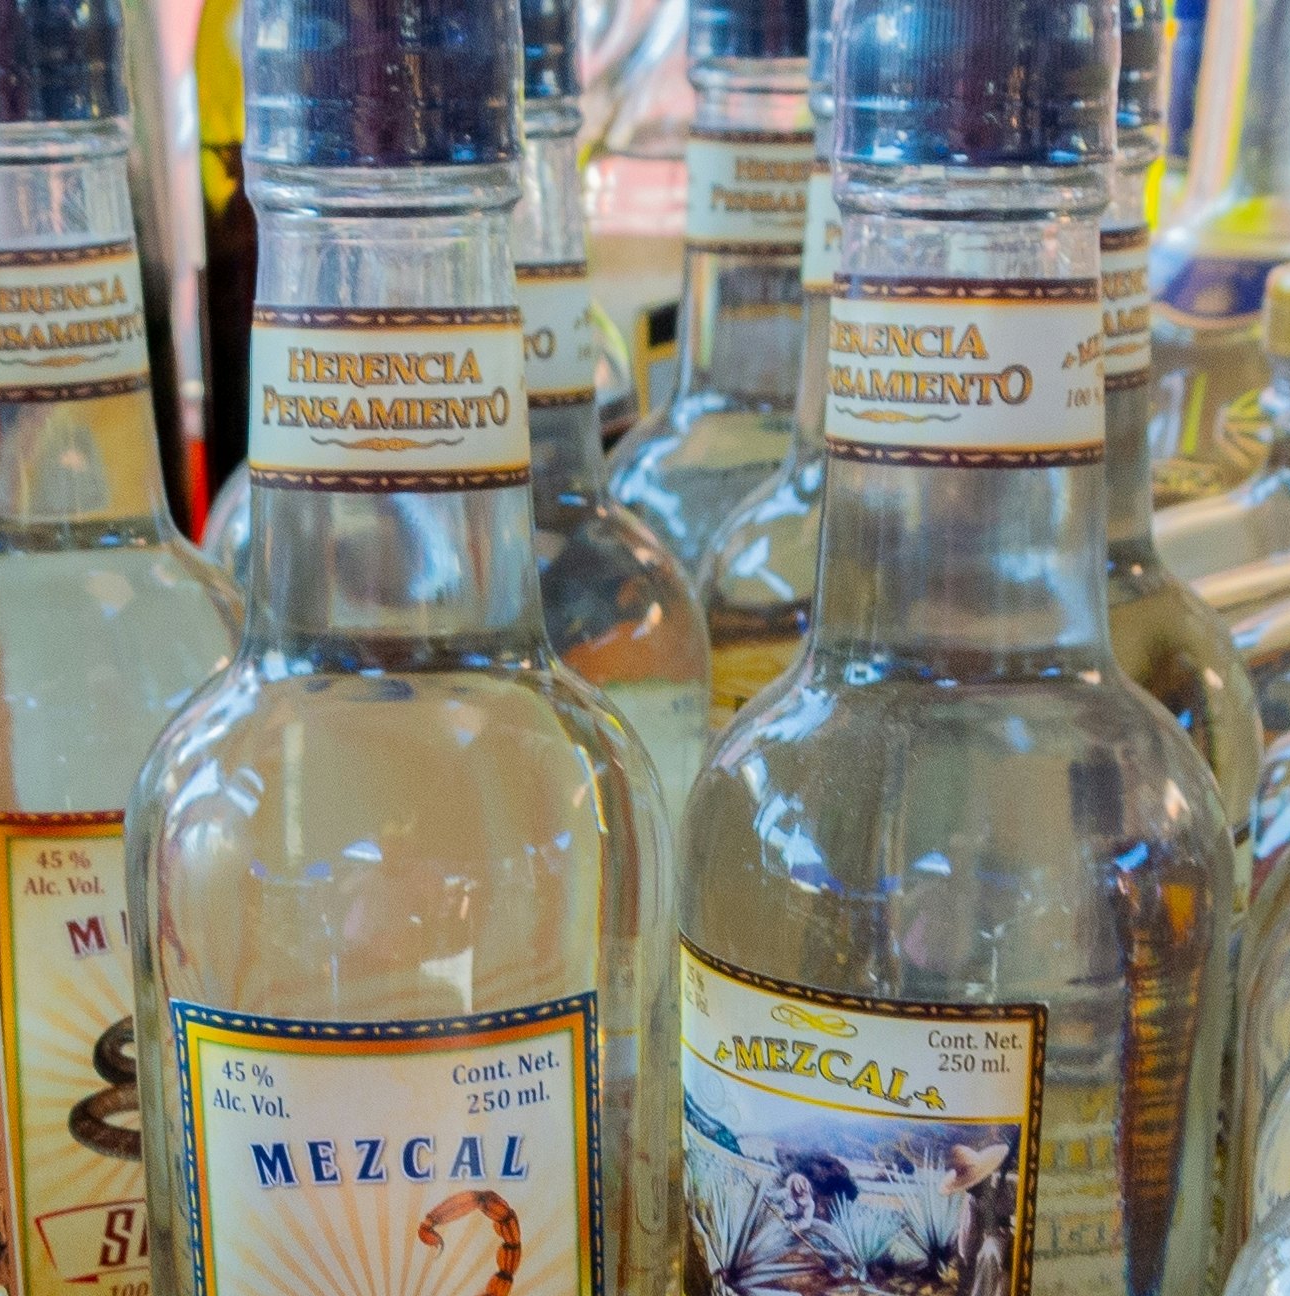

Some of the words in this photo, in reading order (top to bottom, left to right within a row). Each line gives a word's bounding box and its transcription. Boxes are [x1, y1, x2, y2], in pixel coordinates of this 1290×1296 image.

[287, 347, 482, 388] HERENCIA
[262, 385, 509, 430] PENSAMIENTO
[36, 850, 63, 869] 45
[24, 876, 60, 895] Alc.
[66, 876, 105, 896] Vol.
[928, 1030, 978, 1050] Cont.
[985, 1031, 1023, 1051] Net.
[222, 1059, 247, 1082] 45
[252, 1063, 275, 1088] %
[453, 1062, 511, 1087] Cont.
[518, 1049, 561, 1076] Net.
[731, 1035, 914, 1107] MEZCAL
[938, 1055, 975, 1073] 250
[981, 1054, 1010, 1074] ml.
[214, 1088, 247, 1114] Alc.
[252, 1094, 291, 1119] Vol.
[468, 1089, 510, 1115] 250
[518, 1082, 551, 1109] ml.
[250, 1131, 529, 1189] MEZCAL
